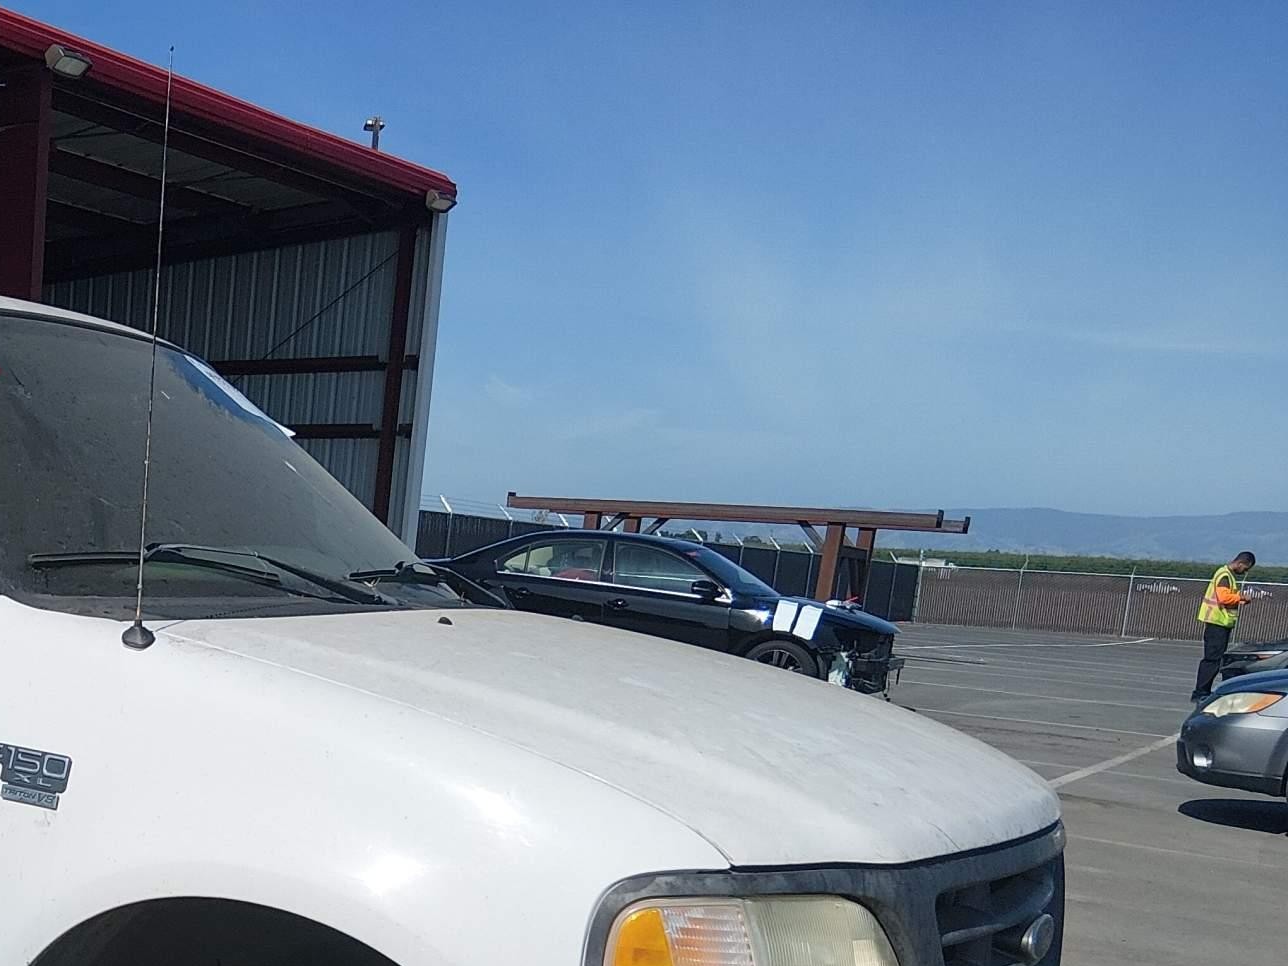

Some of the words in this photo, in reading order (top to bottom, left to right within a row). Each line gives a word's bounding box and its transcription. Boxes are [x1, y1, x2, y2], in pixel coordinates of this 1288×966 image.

[13, 772, 52, 787] XL
[3, 788, 37, 800] TRITON
[37, 792, 57, 804] V8
